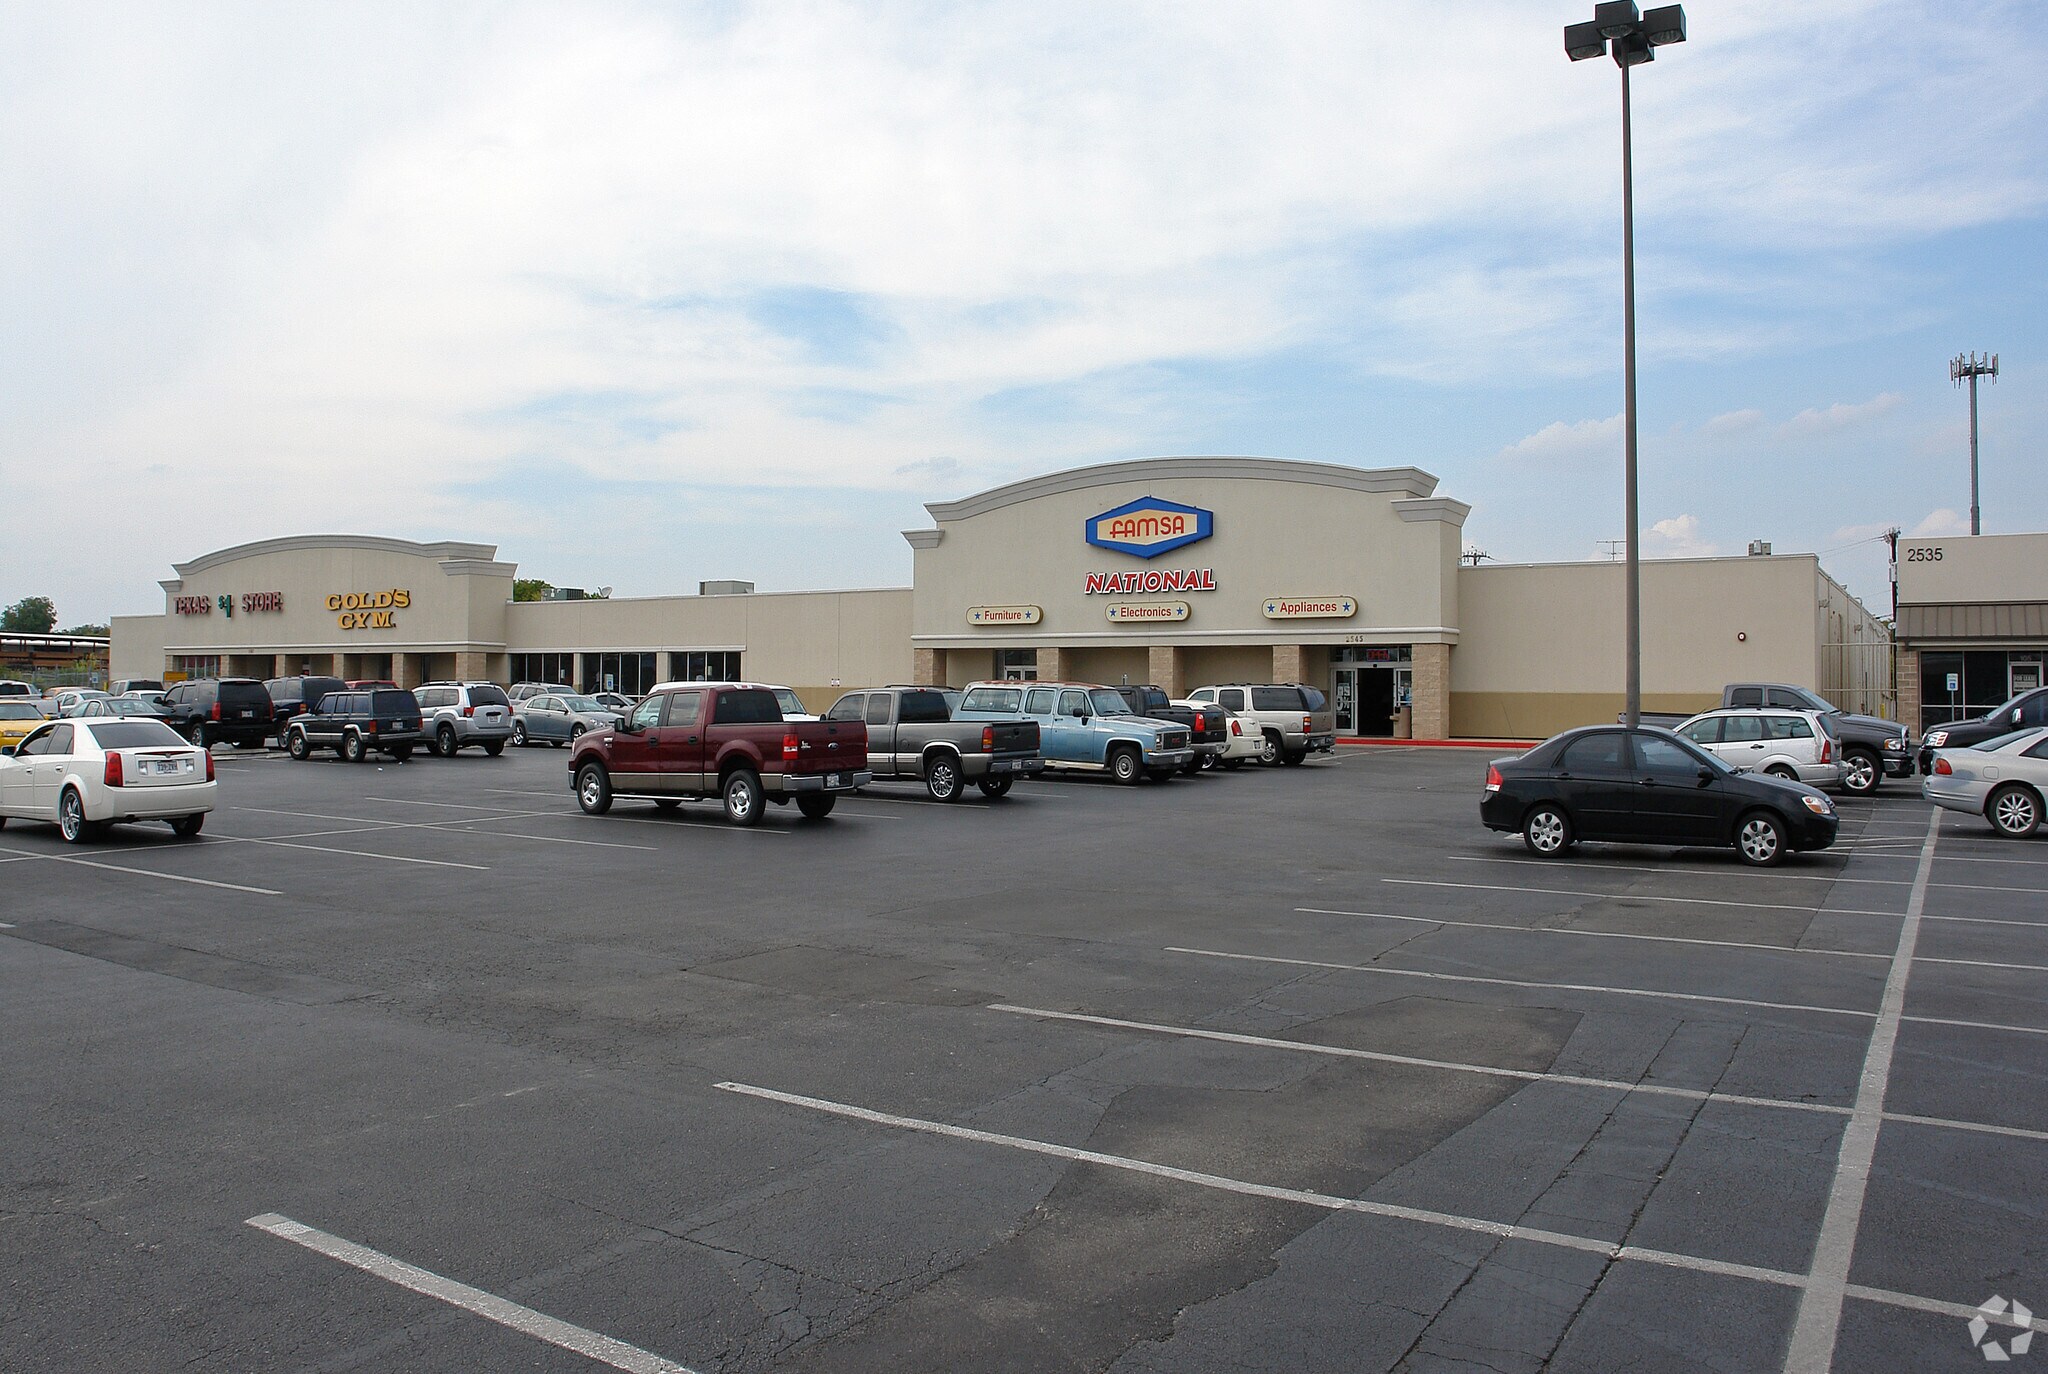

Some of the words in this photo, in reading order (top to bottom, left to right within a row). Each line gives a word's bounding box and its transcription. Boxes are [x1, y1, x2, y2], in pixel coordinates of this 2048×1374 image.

[1109, 515, 1185, 539] FAMSA
[1907, 547, 1943, 562] 2535
[1084, 568, 1217, 595] NATIONAL
[173, 595, 210, 615] TEXAS
[218, 594, 233, 618] $1
[241, 591, 282, 613] STORE
[325, 589, 411, 611] GOLD'S
[984, 610, 1022, 621] Furniture
[1120, 606, 1172, 618] Electronics
[1279, 602, 1337, 615] Appliances
[1345, 635, 1364, 643] 2545
